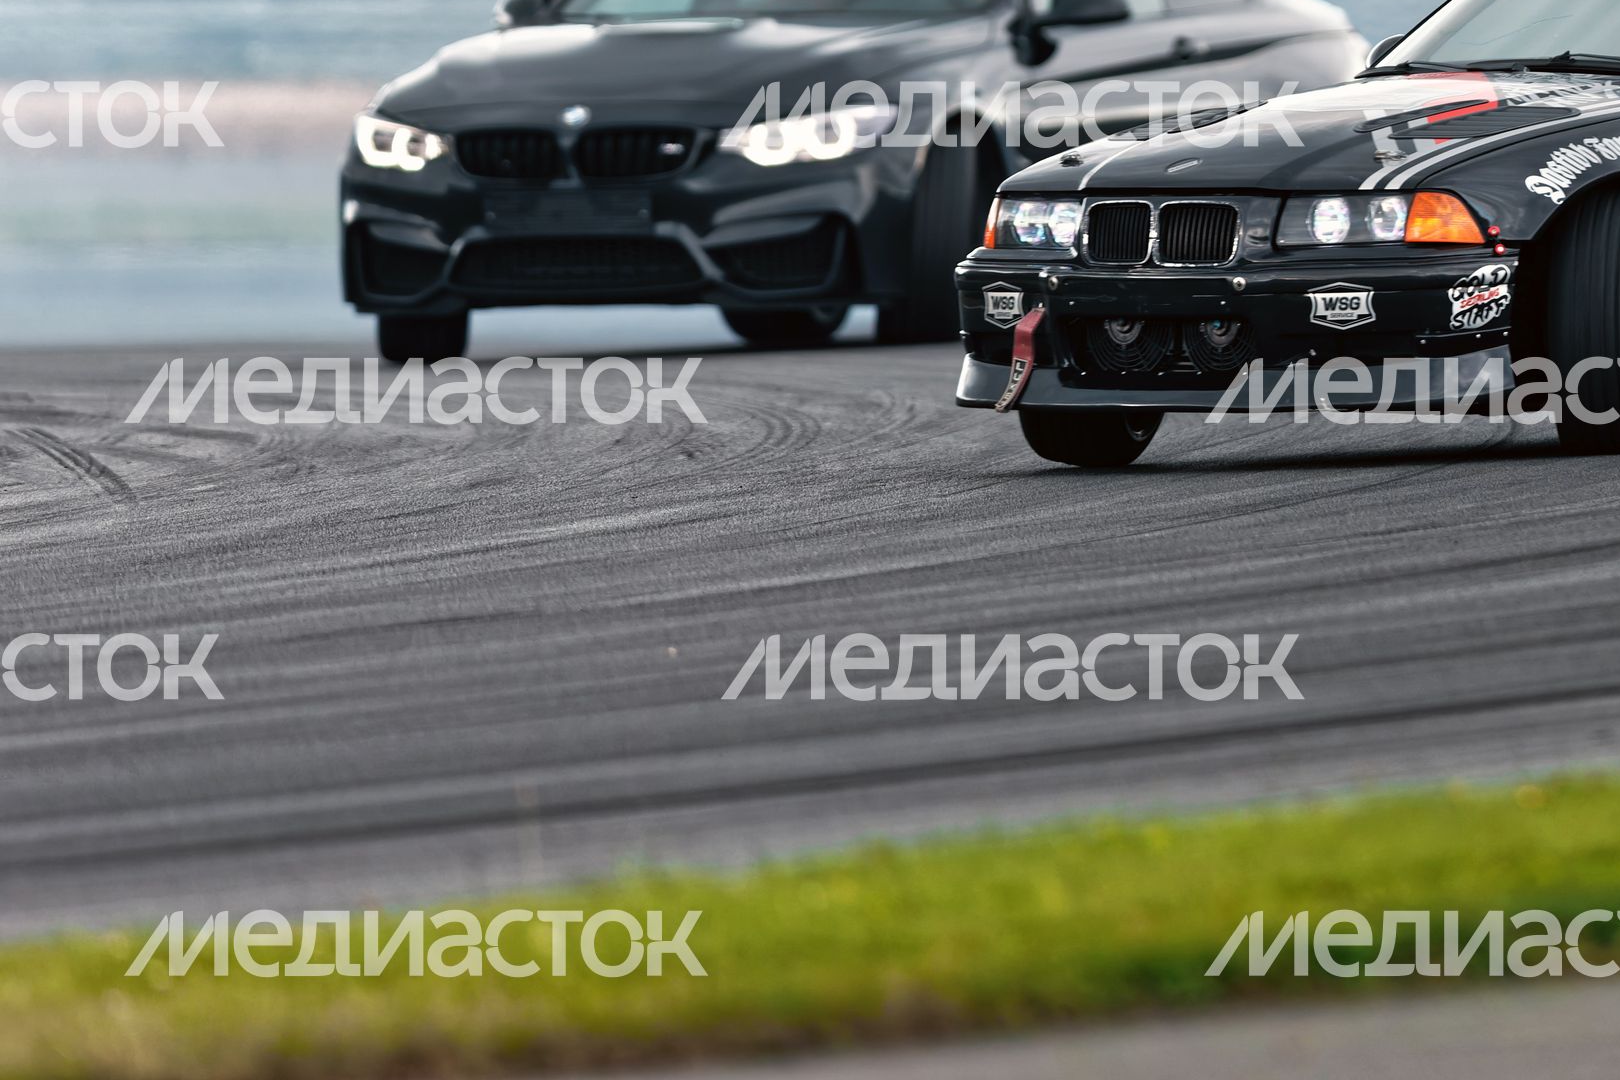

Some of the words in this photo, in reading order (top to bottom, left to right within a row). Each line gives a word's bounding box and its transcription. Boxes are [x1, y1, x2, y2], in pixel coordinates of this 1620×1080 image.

[1452, 266, 1508, 302] GOLD
[990, 296, 1015, 310] WSG
[1321, 296, 1361, 311] WSG
[1452, 294, 1509, 329] STAFF
